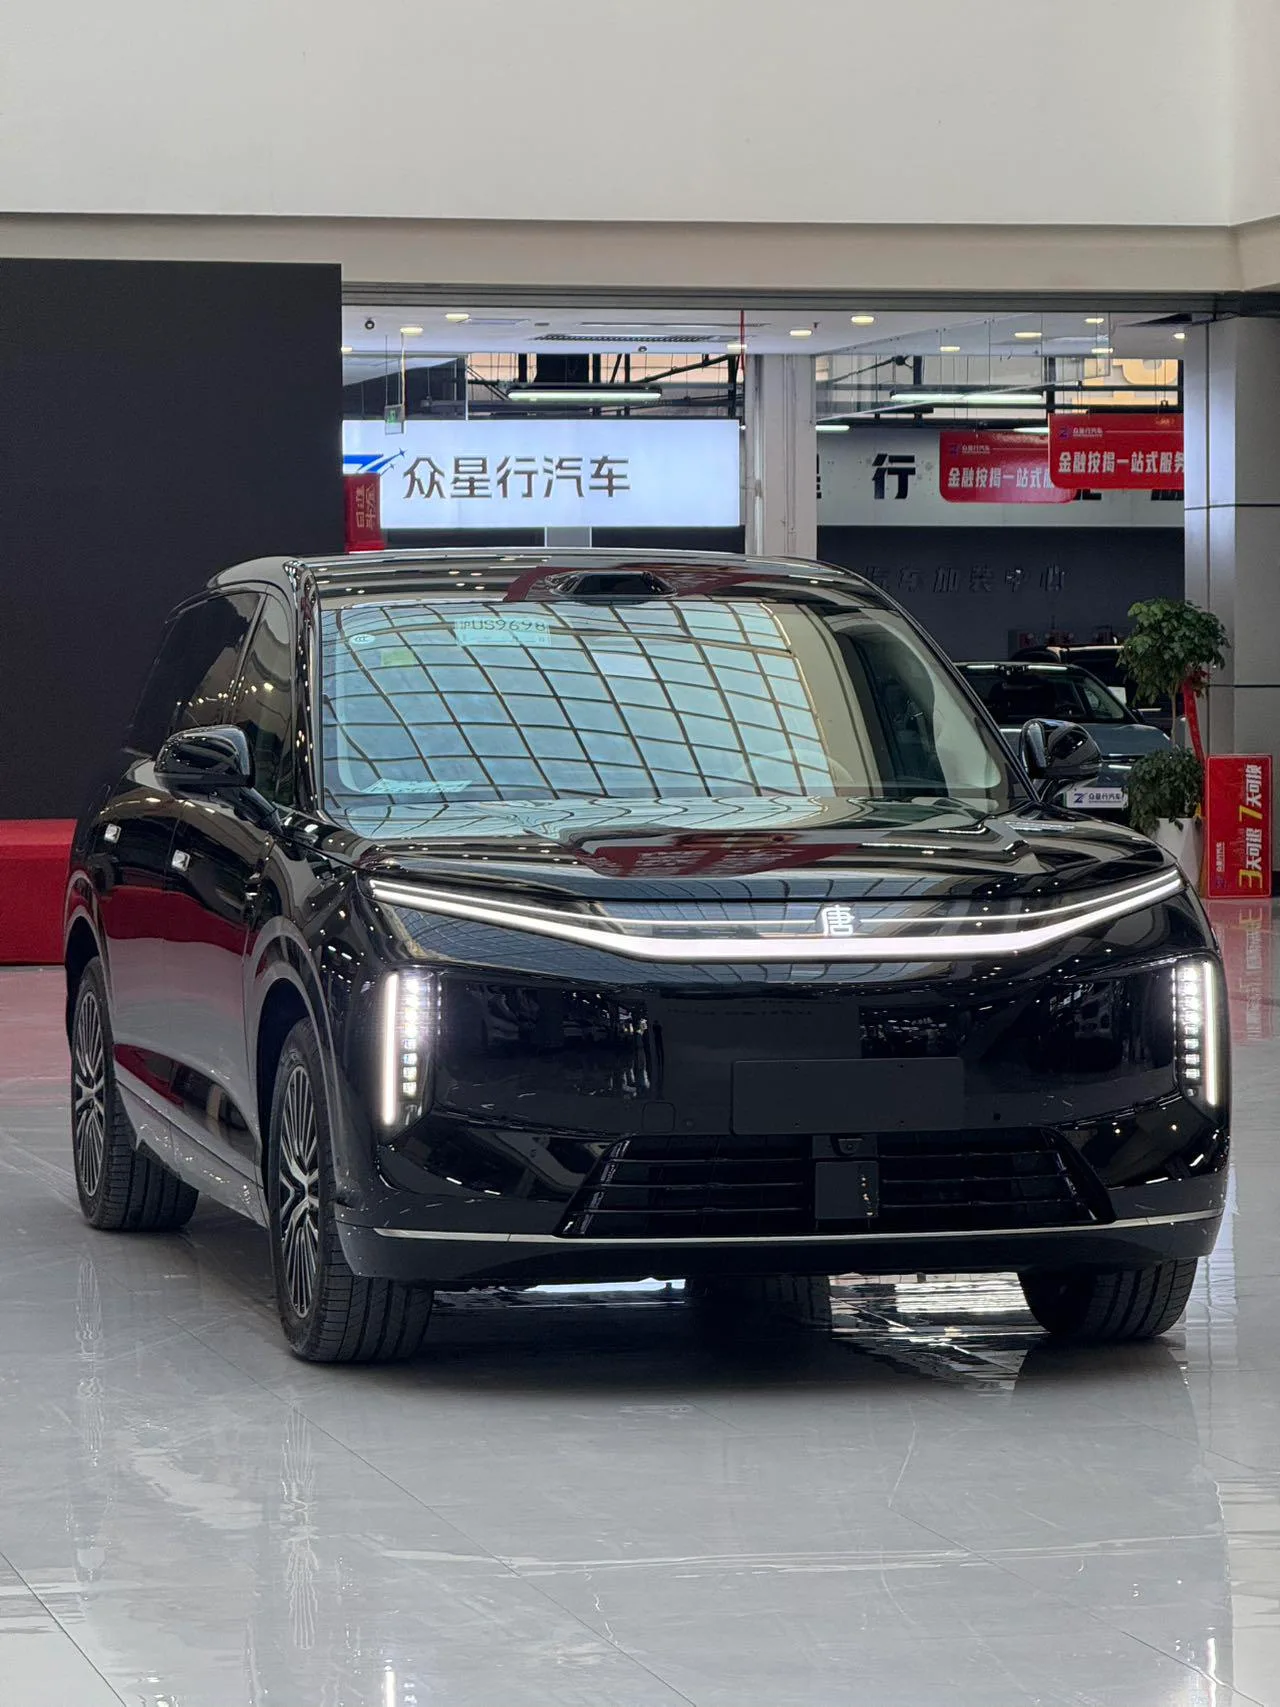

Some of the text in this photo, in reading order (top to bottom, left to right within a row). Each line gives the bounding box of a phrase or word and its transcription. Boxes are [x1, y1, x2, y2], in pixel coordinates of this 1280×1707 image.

[402, 455, 630, 499] 众星行汽车
[821, 904, 855, 937] 唐
